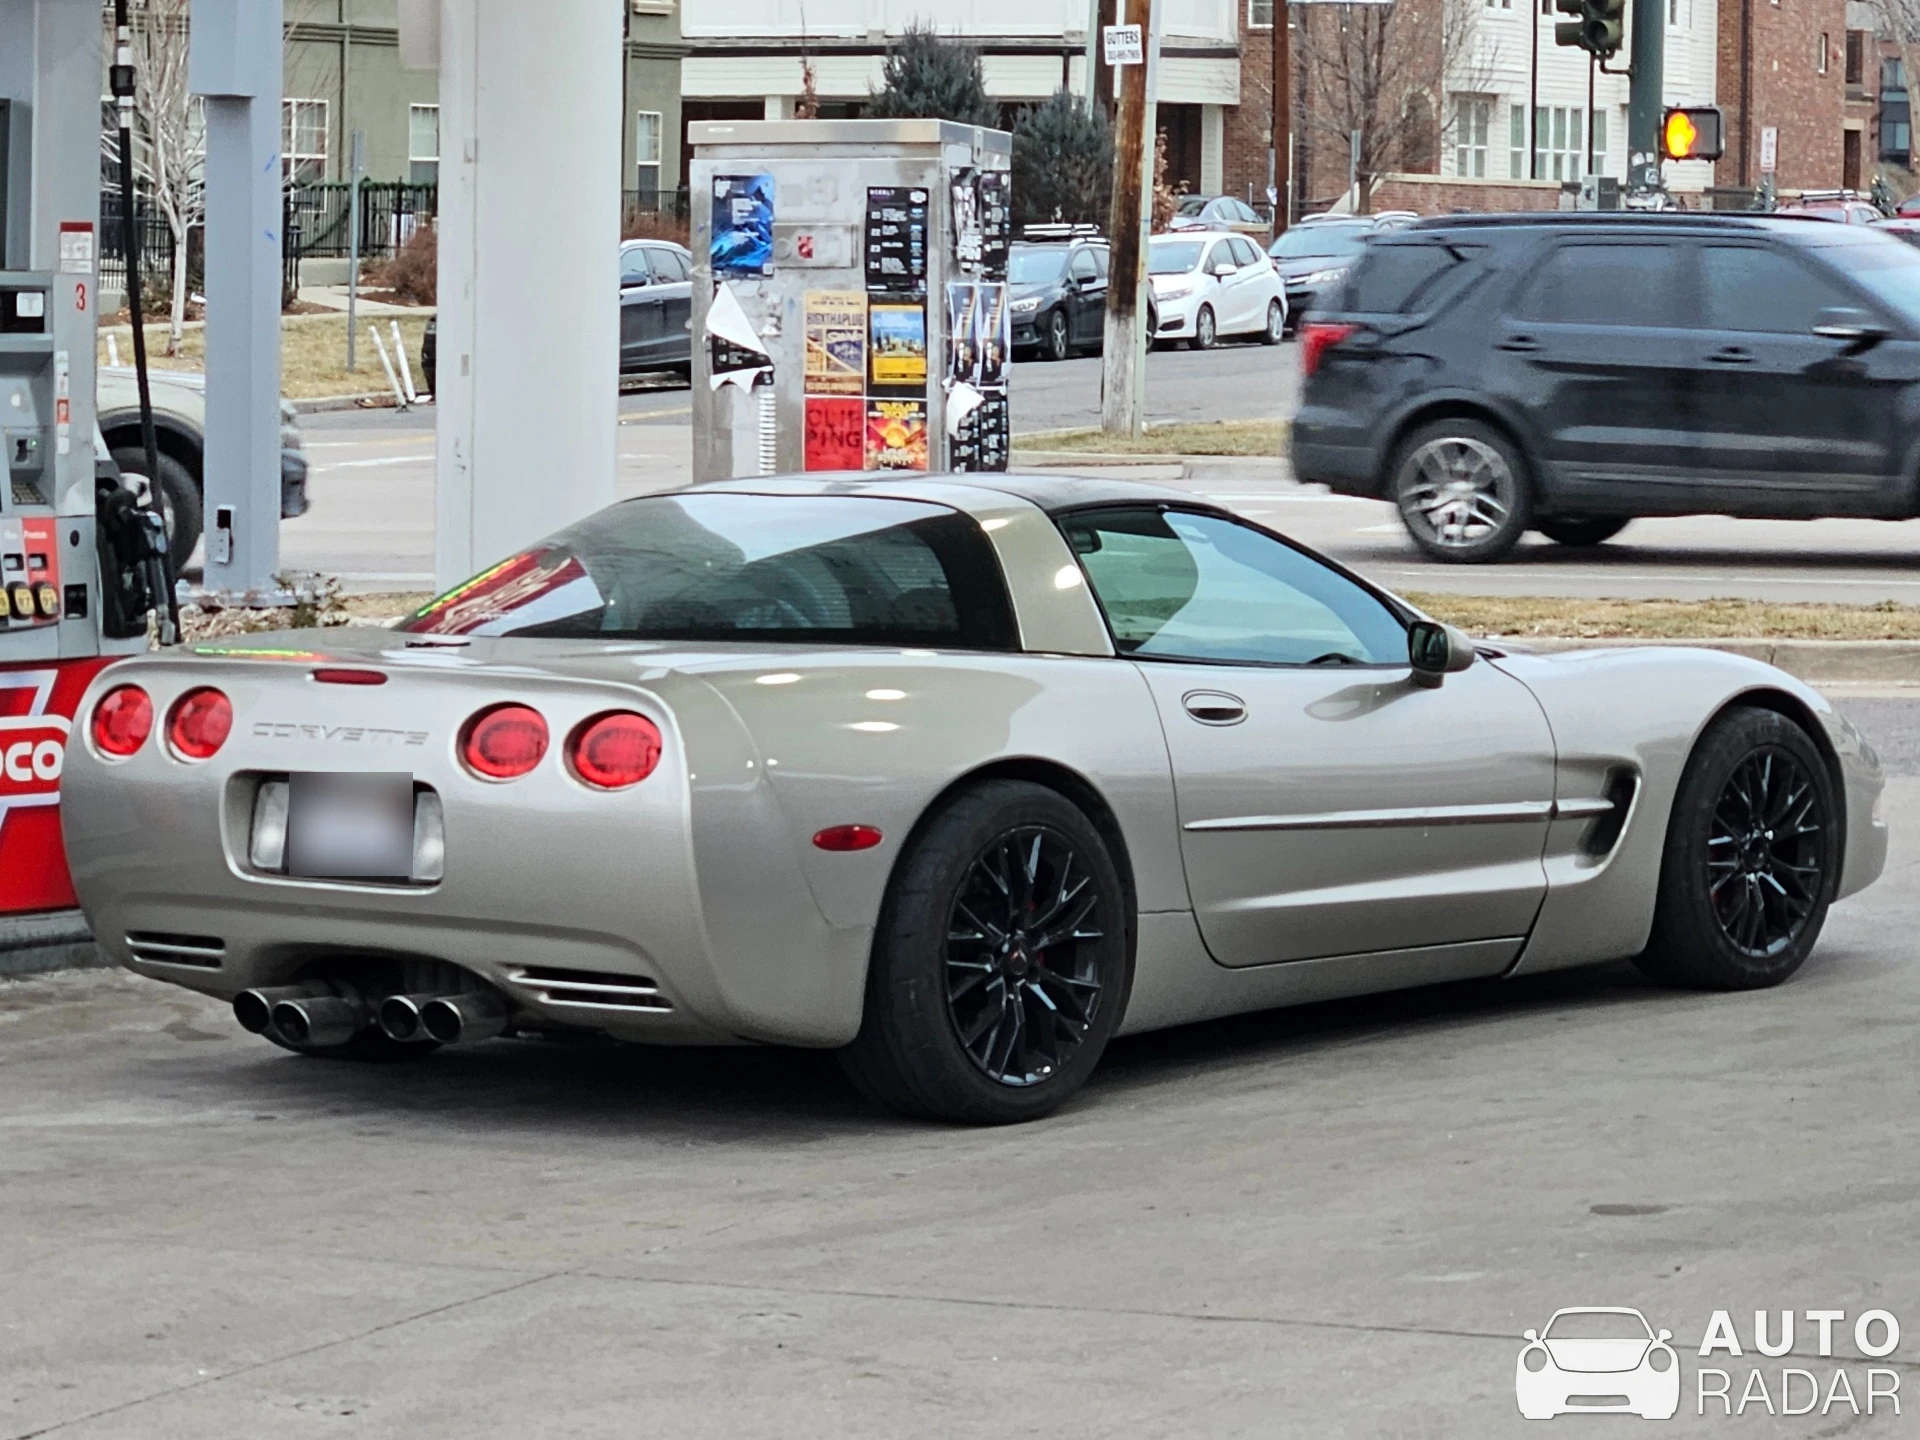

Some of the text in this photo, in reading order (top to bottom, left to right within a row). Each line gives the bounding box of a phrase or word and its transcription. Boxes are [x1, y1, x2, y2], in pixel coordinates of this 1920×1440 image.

[1106, 31, 1139, 44] GUTTERS
[76, 283, 86, 311] 3
[253, 722, 430, 746] CORVETTE
